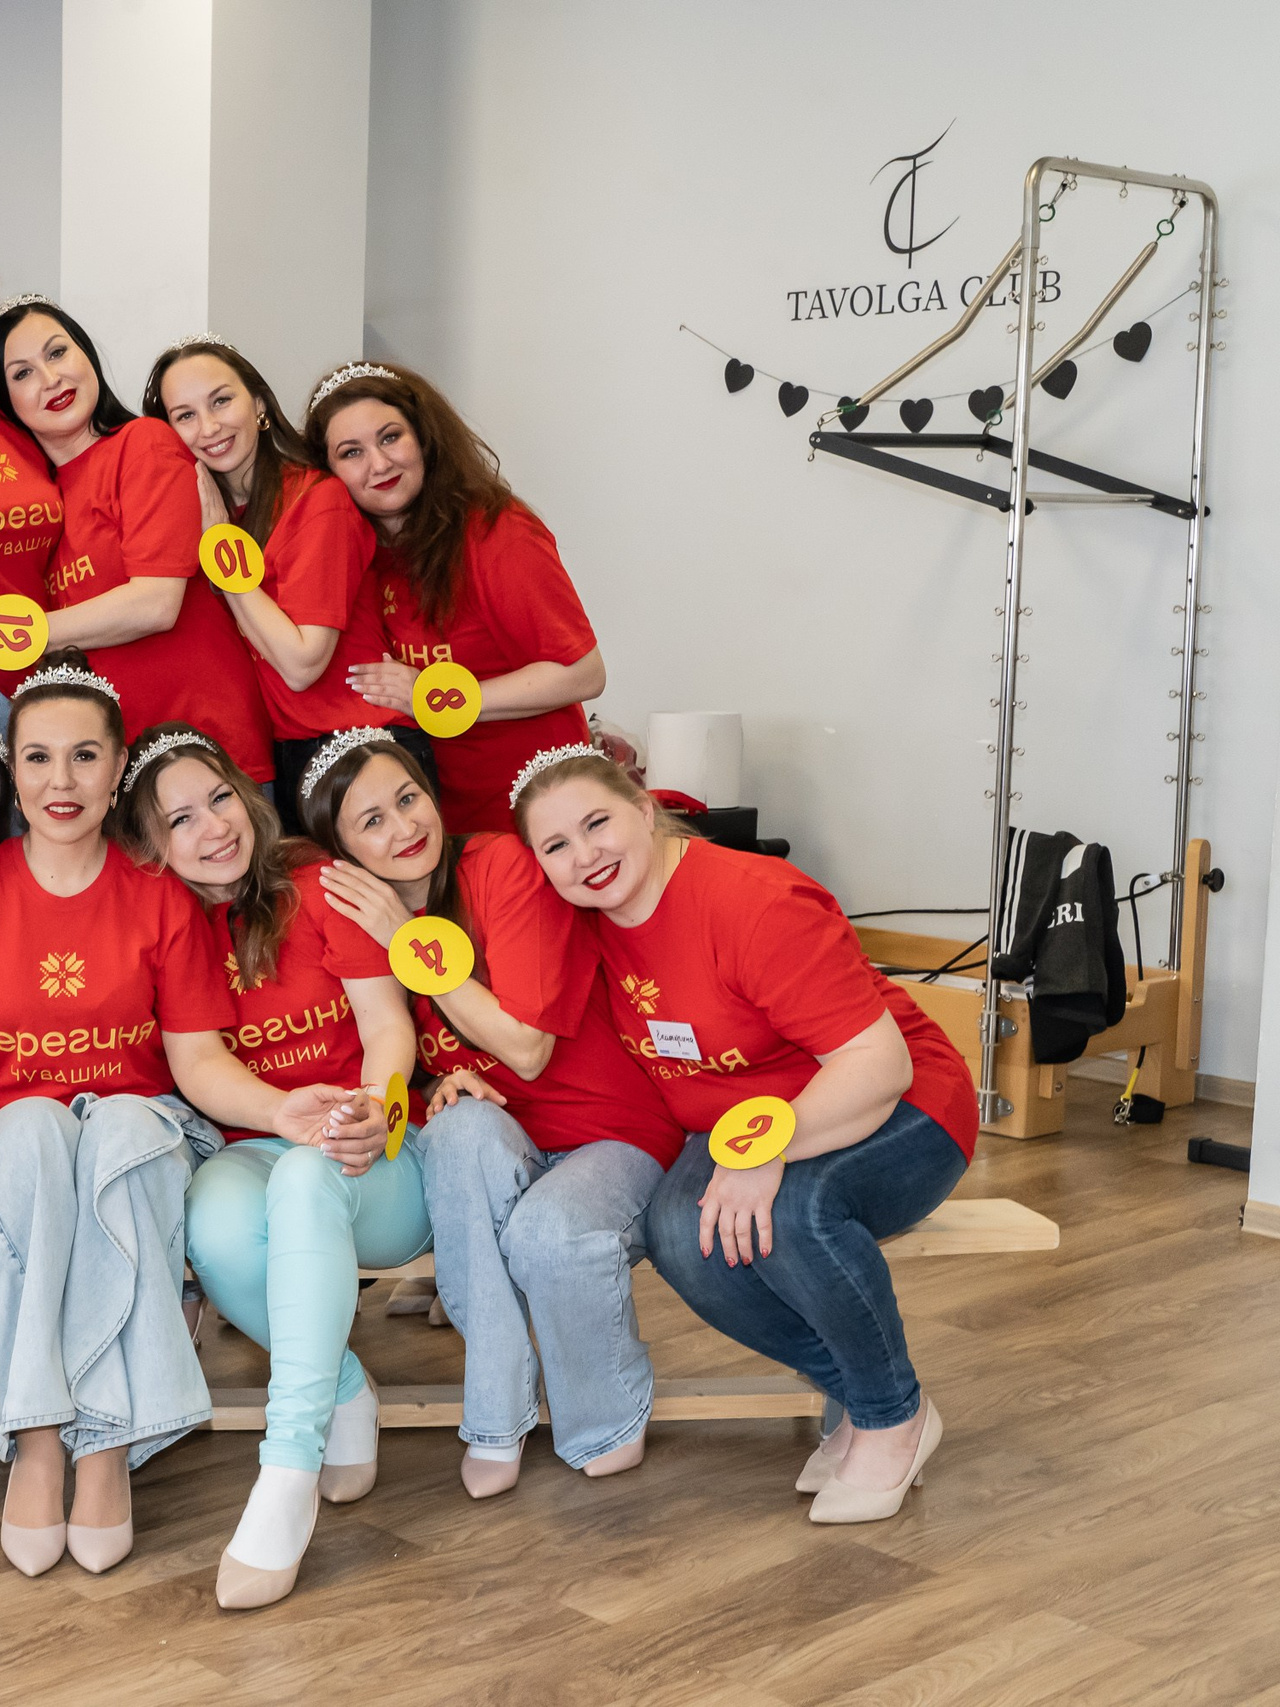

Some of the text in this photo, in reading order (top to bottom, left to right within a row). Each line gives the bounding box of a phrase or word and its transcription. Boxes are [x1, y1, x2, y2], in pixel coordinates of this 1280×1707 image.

[787, 279, 948, 322] TAVOLGA
[214, 538, 252, 578] 10
[425, 688, 467, 713] 8
[408, 938, 448, 977] 4
[10, 1061, 122, 1084] чувашии
[247, 1042, 328, 1075] вашии
[725, 1115, 774, 1155] 2
